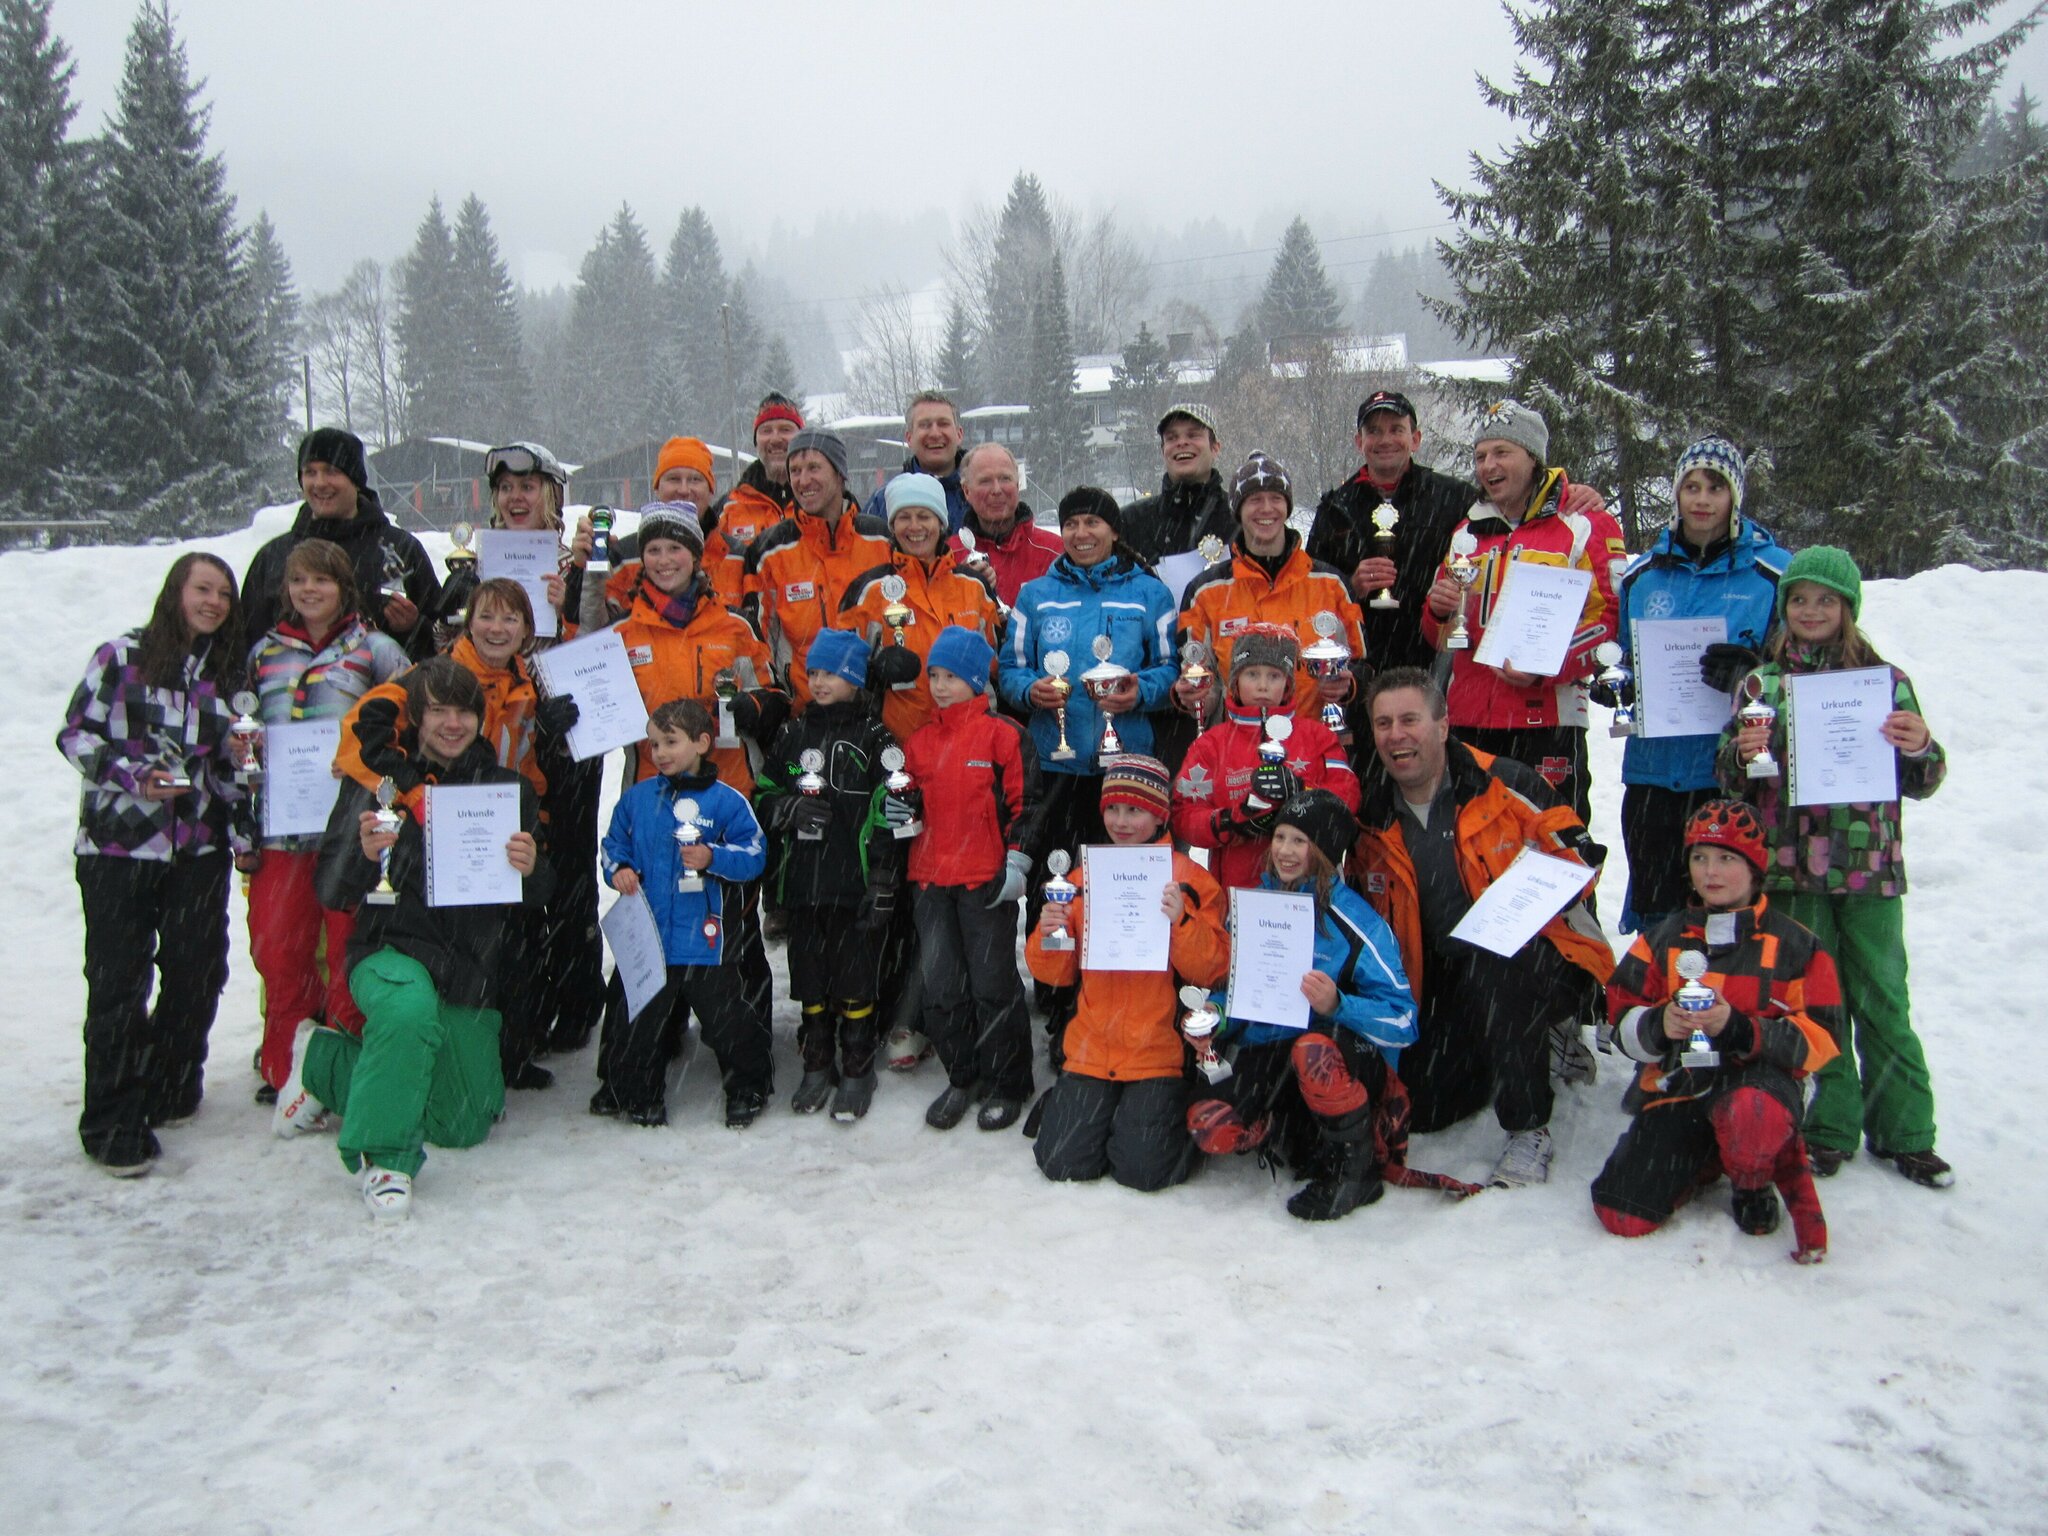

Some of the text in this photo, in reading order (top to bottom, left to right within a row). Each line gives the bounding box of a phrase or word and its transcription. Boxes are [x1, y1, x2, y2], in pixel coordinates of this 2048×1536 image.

[504, 552, 536, 560] Urkunde
[1530, 590, 1562, 600] Urkunde
[1664, 642, 1702, 652] Urkunde
[574, 661, 607, 677] Urkunde
[1821, 698, 1863, 710] Urkunde
[288, 744, 320, 755] Urkunde
[457, 808, 495, 819] Urkunde
[1112, 873, 1148, 881] Urkunde
[1258, 919, 1292, 930] Urkunde
